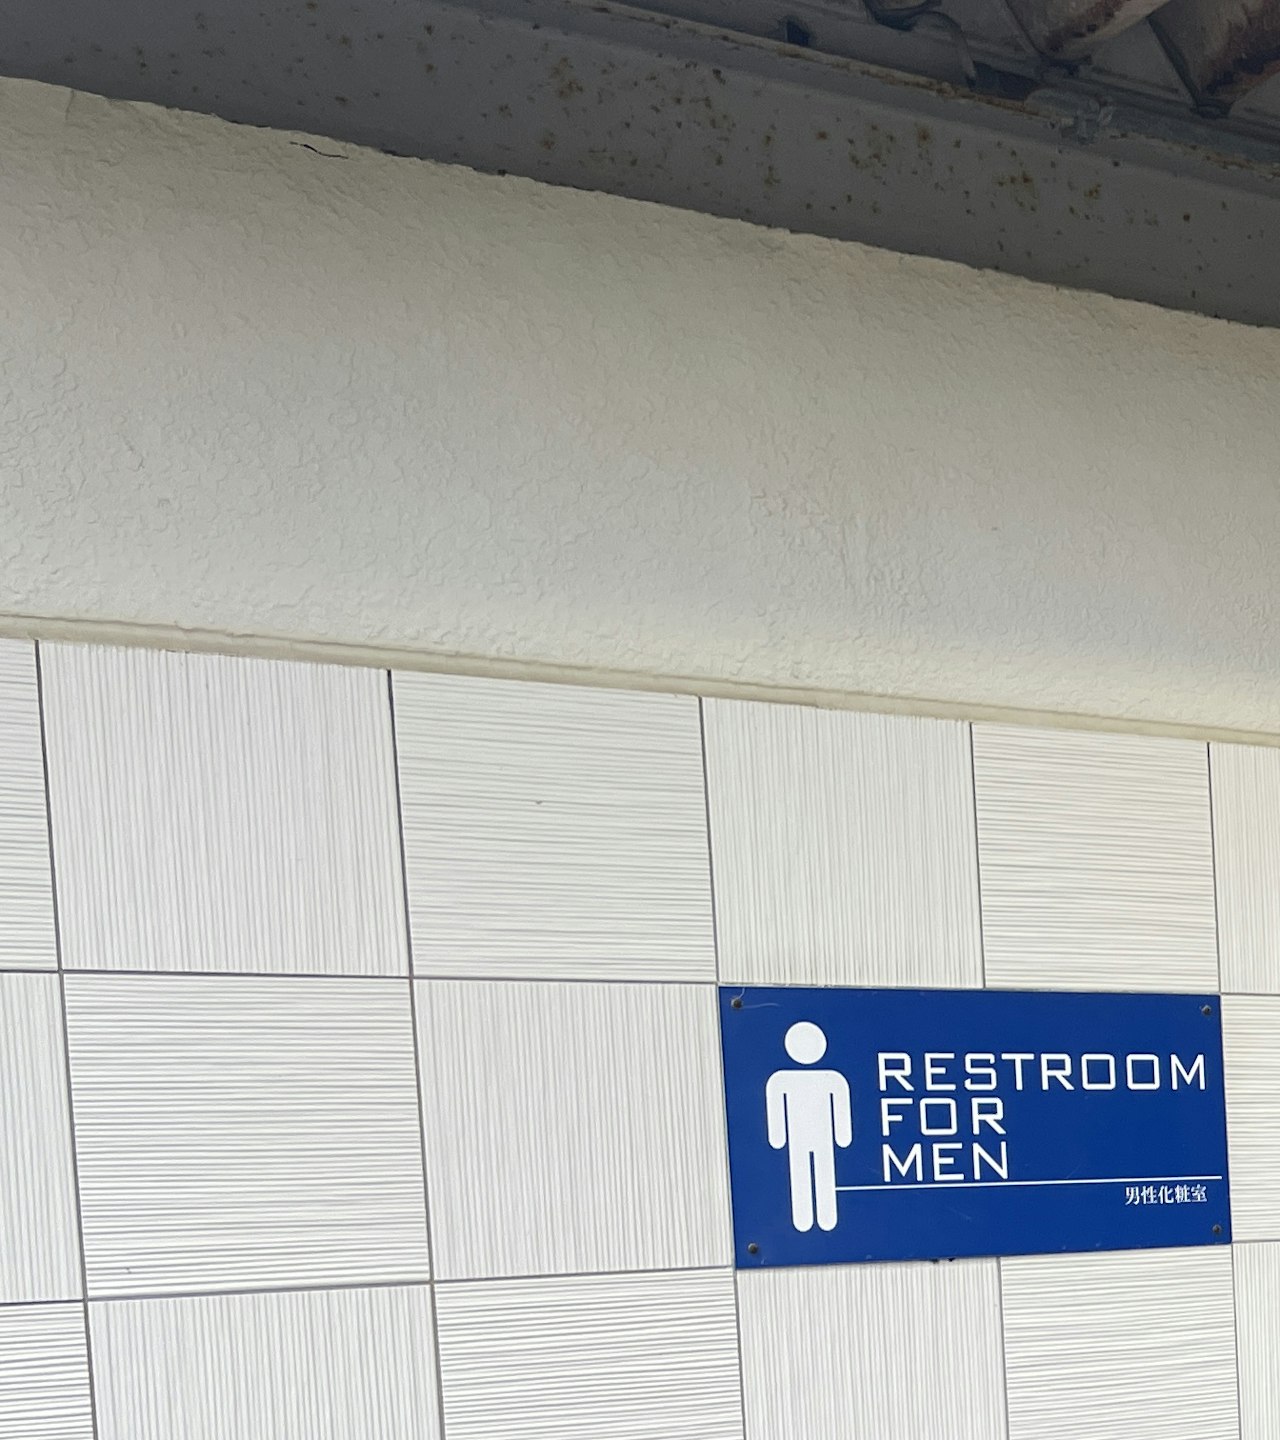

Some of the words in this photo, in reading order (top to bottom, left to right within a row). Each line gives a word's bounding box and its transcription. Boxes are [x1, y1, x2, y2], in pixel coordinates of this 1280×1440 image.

[877, 1052, 1206, 1091] RESTROOM
[881, 1096, 1006, 1136] FOR
[882, 1141, 1009, 1181] MEN
[1125, 1184, 1208, 1205] 男性化粧室
